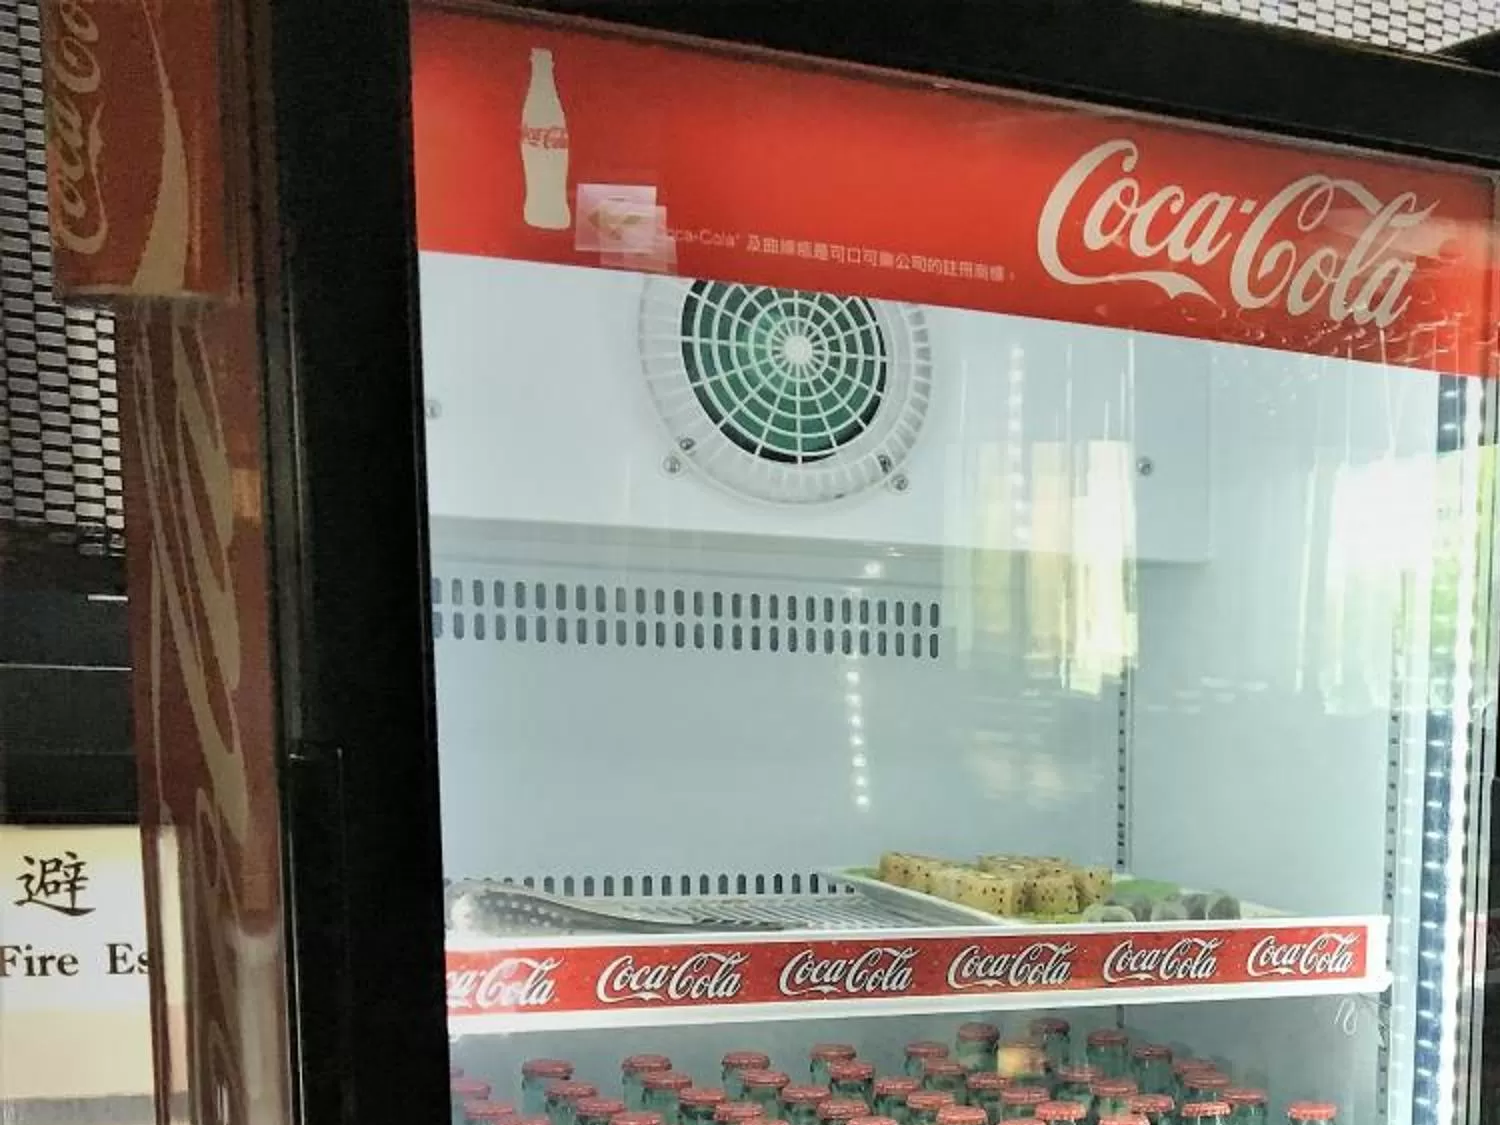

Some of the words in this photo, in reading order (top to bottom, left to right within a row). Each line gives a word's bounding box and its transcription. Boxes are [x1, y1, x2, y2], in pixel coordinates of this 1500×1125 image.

[1037, 139, 1440, 328] Coca-Cola
[14, 851, 96, 917] 避
[0, 943, 80, 977] Fire
[596, 952, 750, 1003] Coca-Cola
[779, 947, 919, 995] Coca-Cola
[947, 942, 1077, 989] Coca-Cola
[1103, 938, 1223, 983] Coca-Cola
[1247, 932, 1360, 977] Coca-Cola
